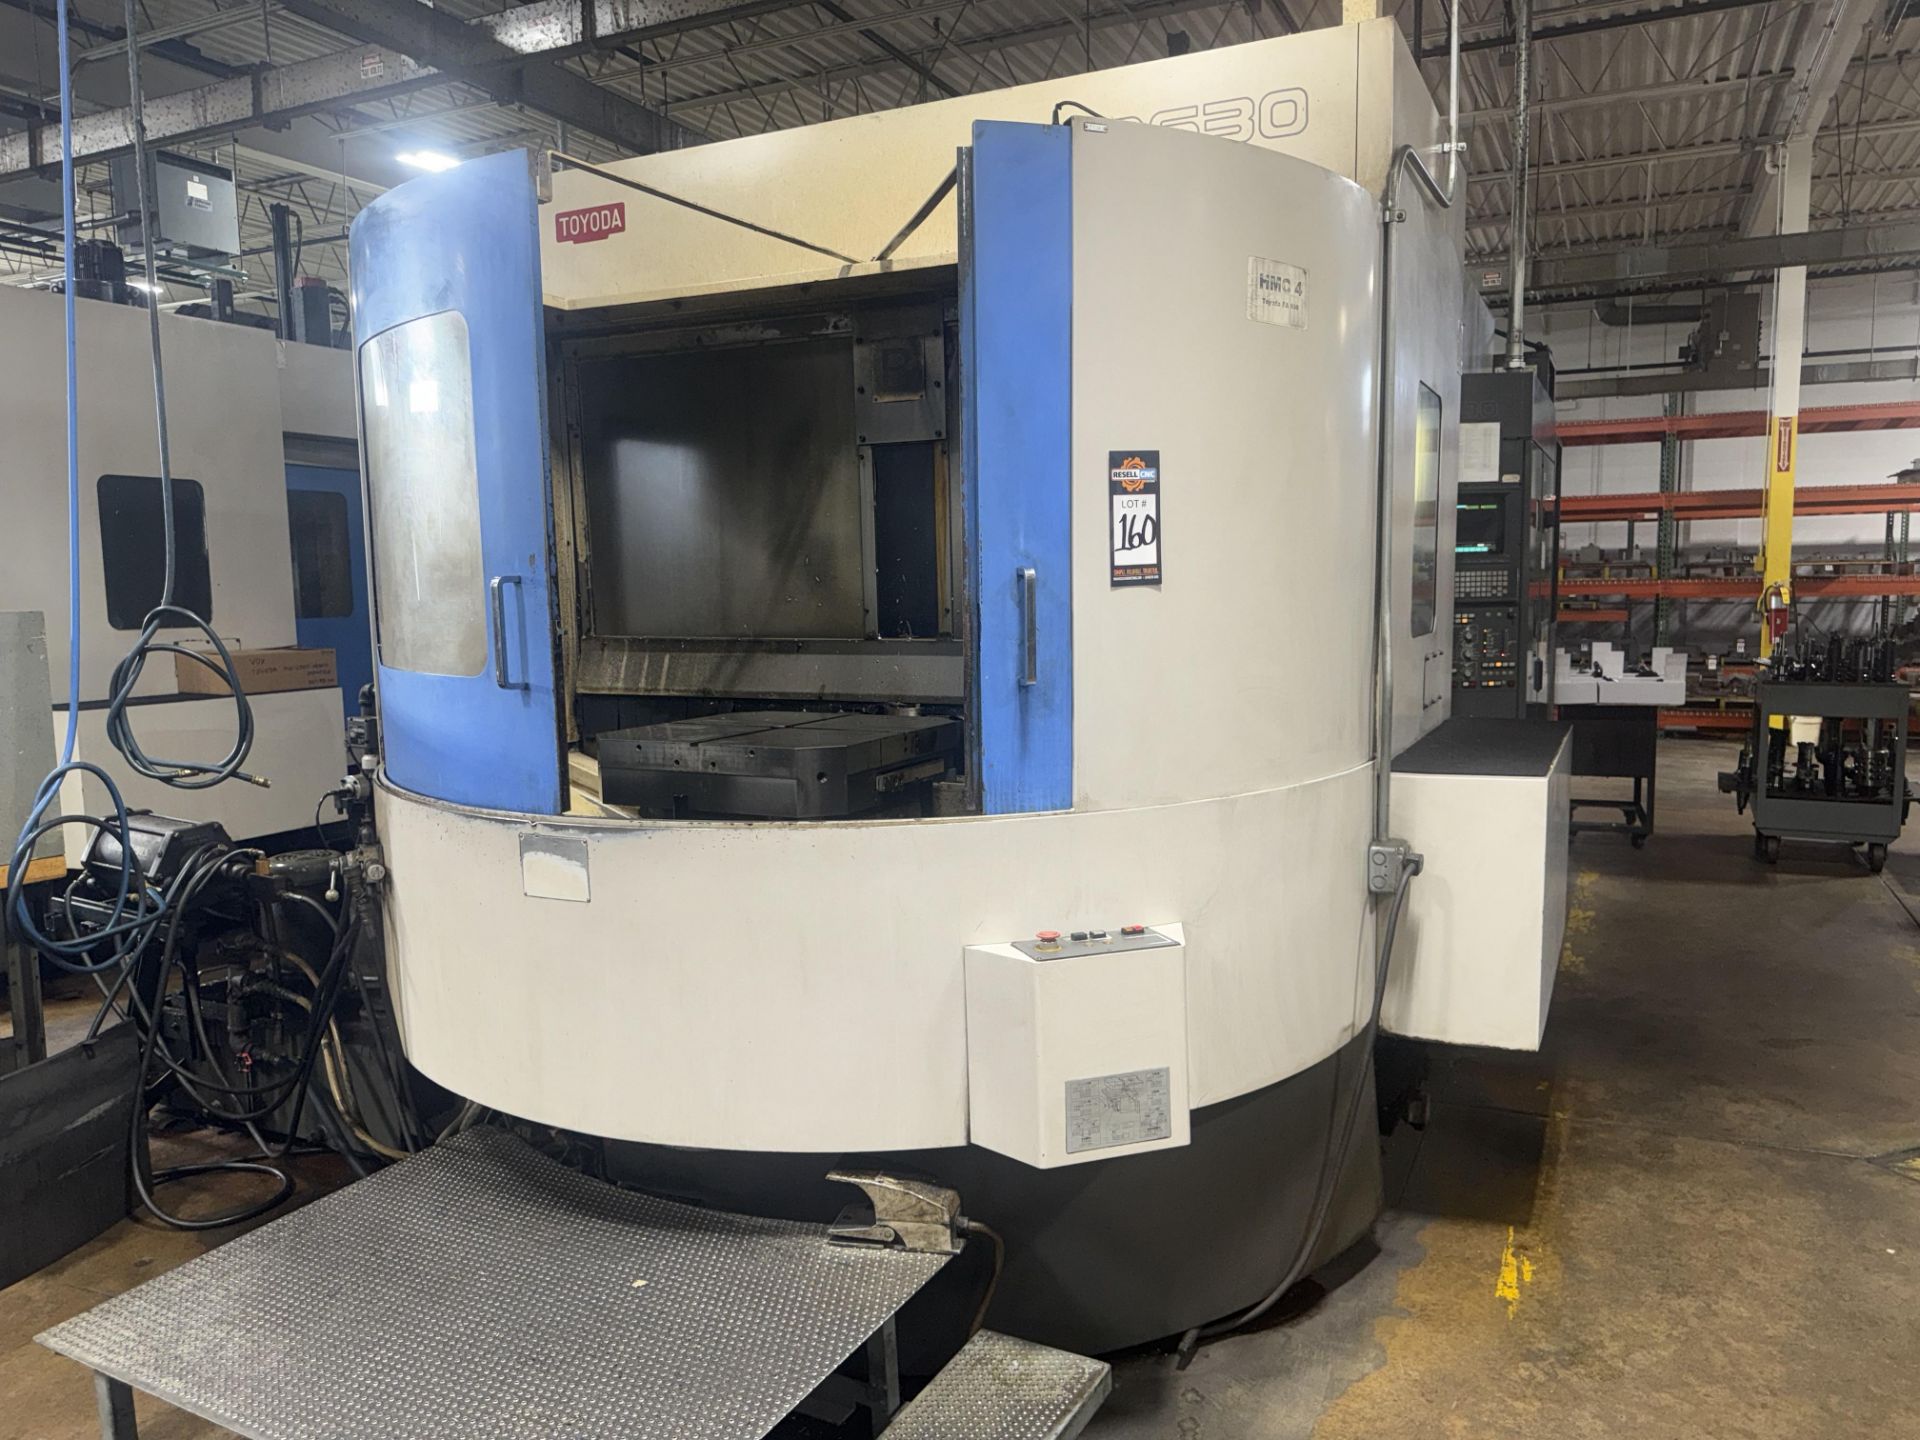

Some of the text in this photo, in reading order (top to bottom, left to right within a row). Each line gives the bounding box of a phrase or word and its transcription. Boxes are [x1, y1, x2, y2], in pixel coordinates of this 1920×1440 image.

[559, 208, 622, 237] TOYODA
[1295, 281, 1302, 296] 4
[1122, 500, 1147, 509] LOT #
[1115, 513, 1156, 551] 160
